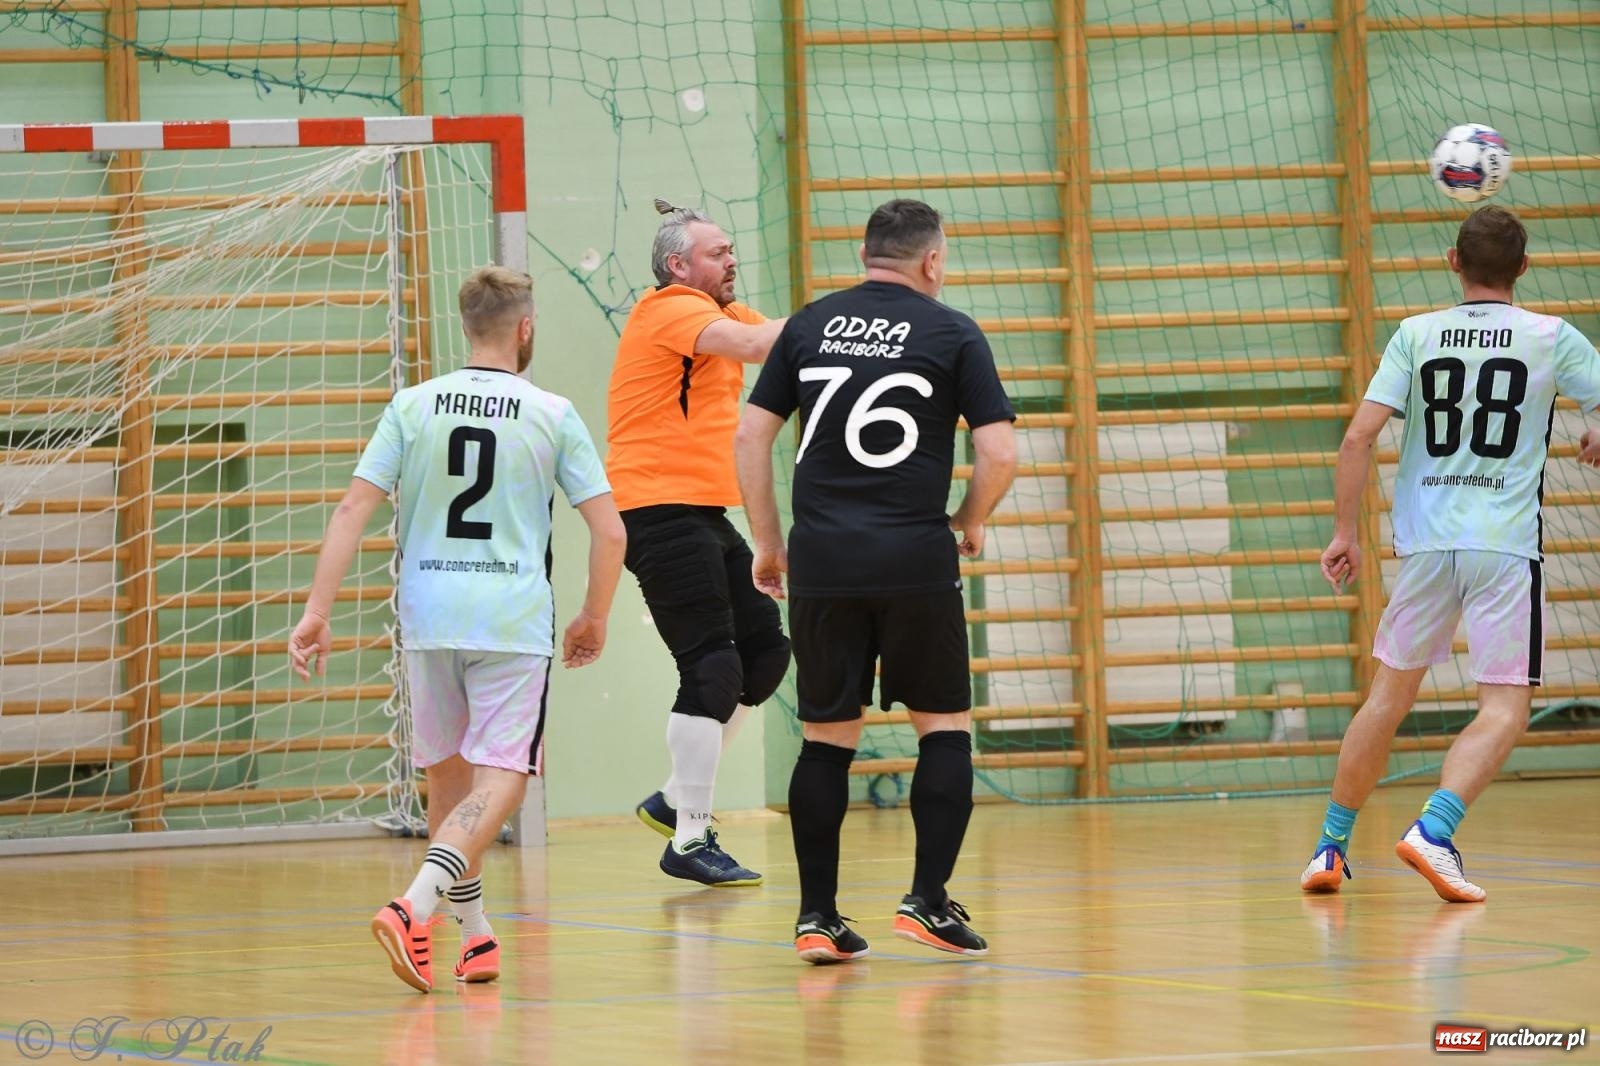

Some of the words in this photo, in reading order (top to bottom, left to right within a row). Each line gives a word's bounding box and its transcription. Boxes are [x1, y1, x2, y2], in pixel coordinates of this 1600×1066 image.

[823, 315, 911, 343] ODRA
[1439, 328, 1513, 348] RAFCIO
[818, 339, 905, 359] RACIBÓRZ
[434, 392, 521, 420] MARCIN
[795, 366, 934, 468] 76
[1420, 357, 1528, 459] 88
[446, 425, 497, 540] 2
[1421, 473, 1505, 491] www.oncetedm.pl
[419, 559, 518, 575] www.concretedm.pl
